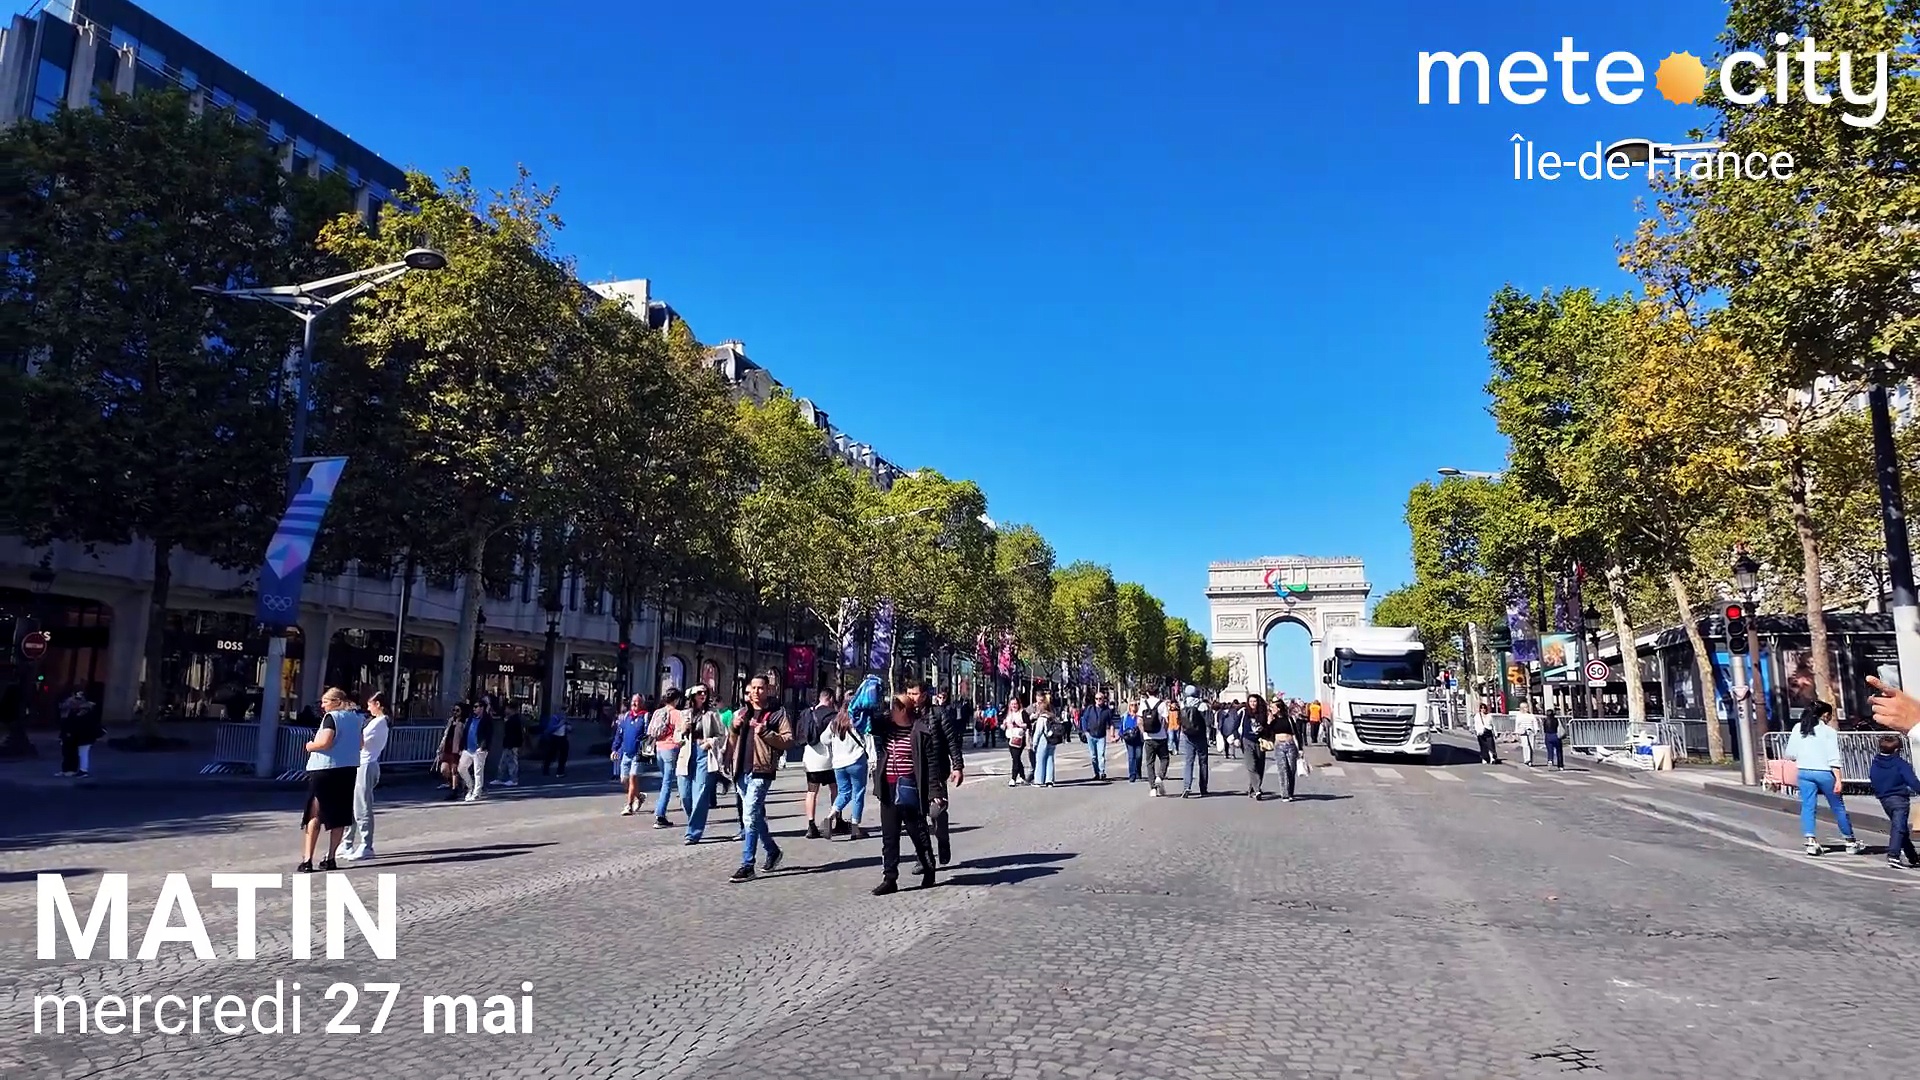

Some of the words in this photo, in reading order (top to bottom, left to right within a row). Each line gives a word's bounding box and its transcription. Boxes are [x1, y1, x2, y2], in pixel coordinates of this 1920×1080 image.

[217, 640, 243, 651] BOSS
[378, 655, 394, 663] BOS
[1591, 667, 1604, 676] 50
